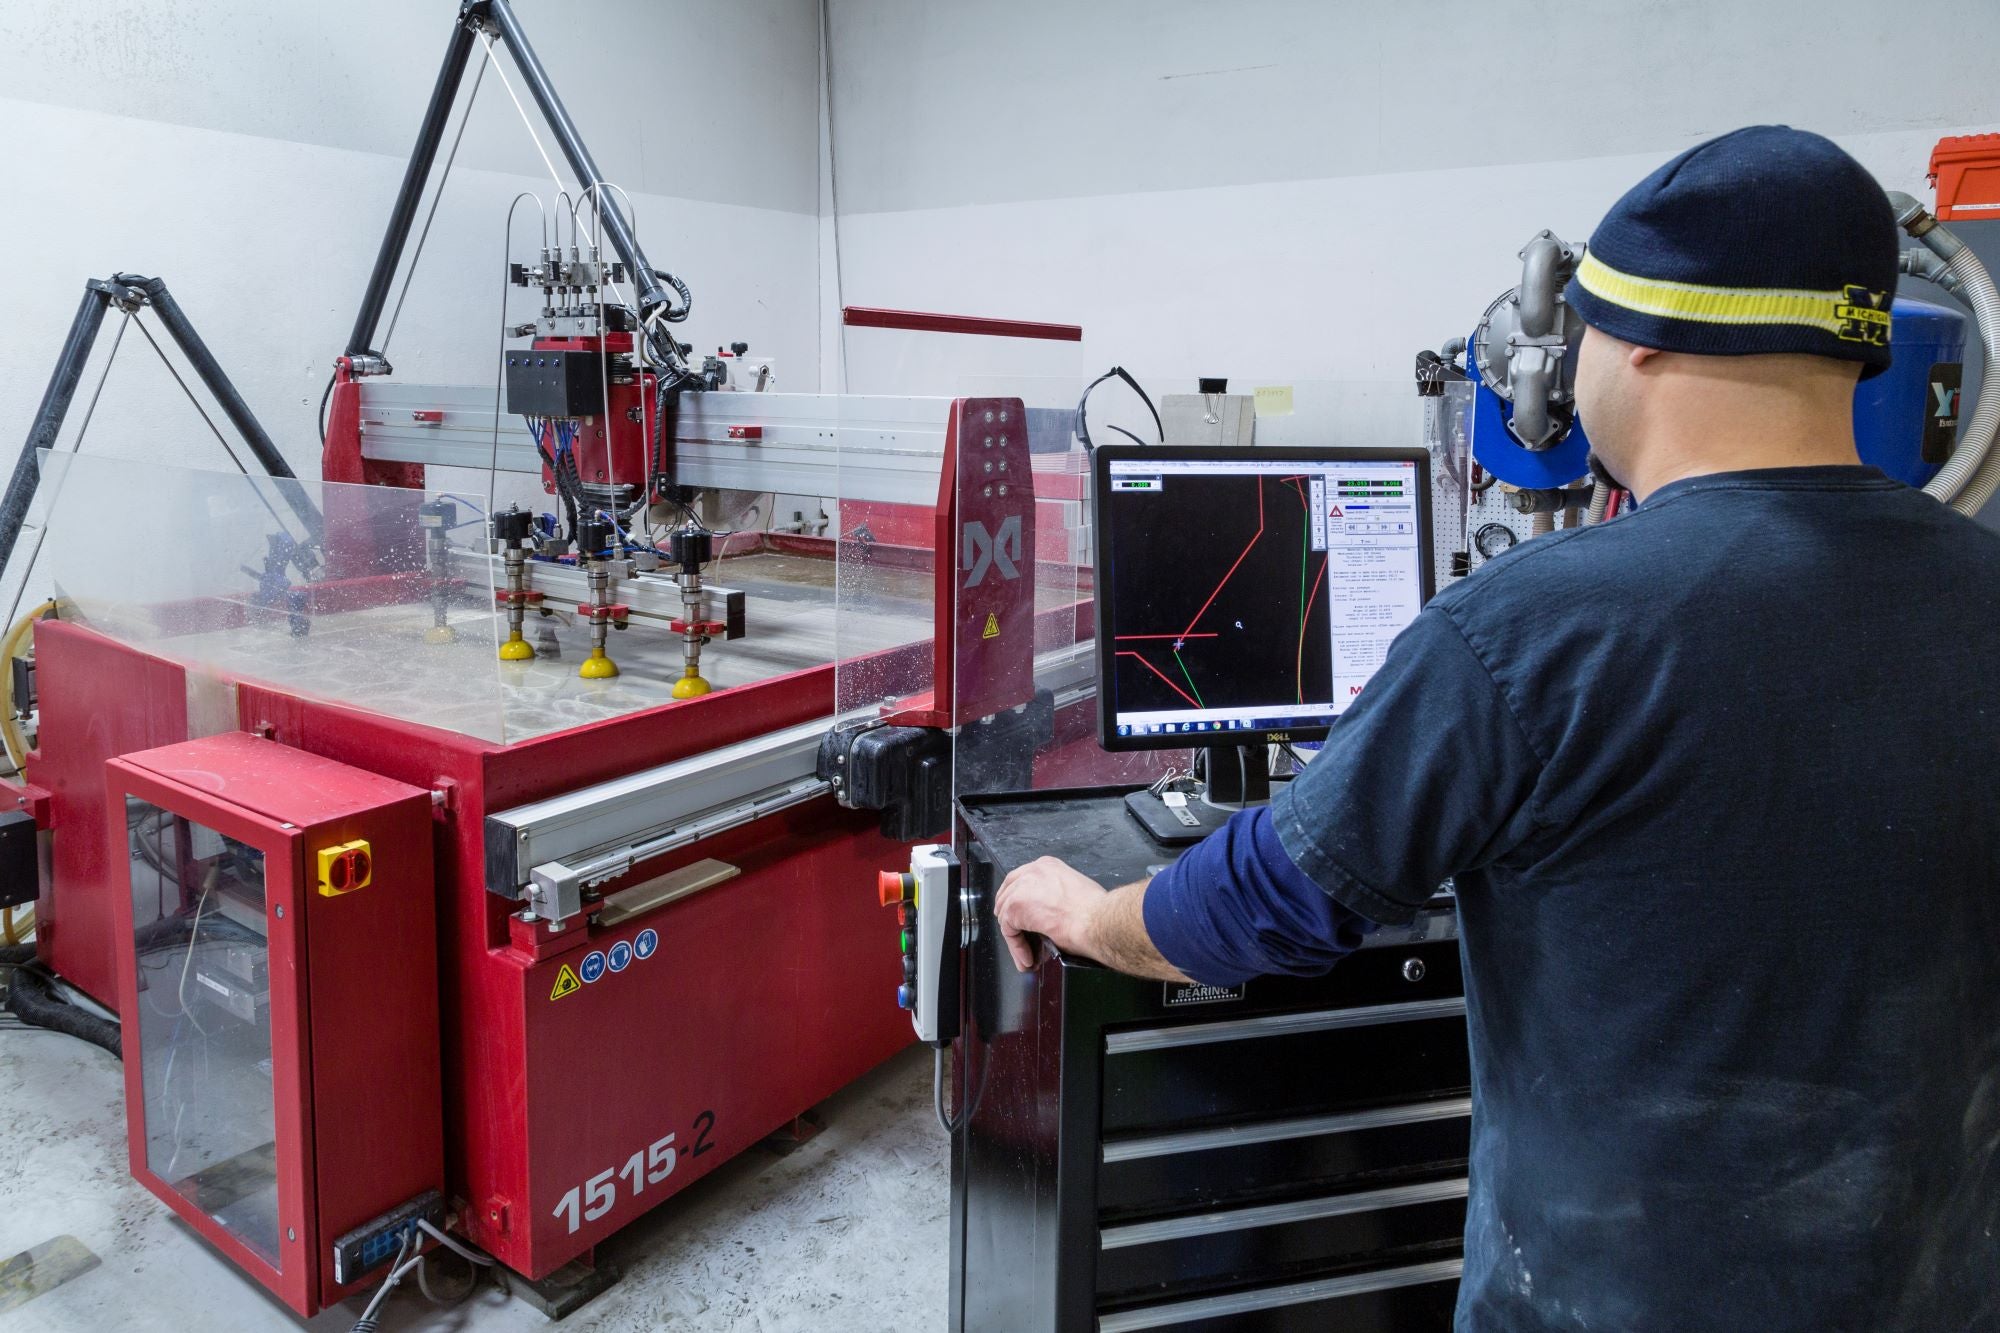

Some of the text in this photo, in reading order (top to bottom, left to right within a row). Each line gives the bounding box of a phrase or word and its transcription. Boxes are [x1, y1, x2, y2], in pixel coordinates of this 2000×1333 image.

[1267, 732, 1290, 742] DELL
[1177, 986, 1229, 999] BEARING
[552, 1110, 715, 1235] 1515-2
